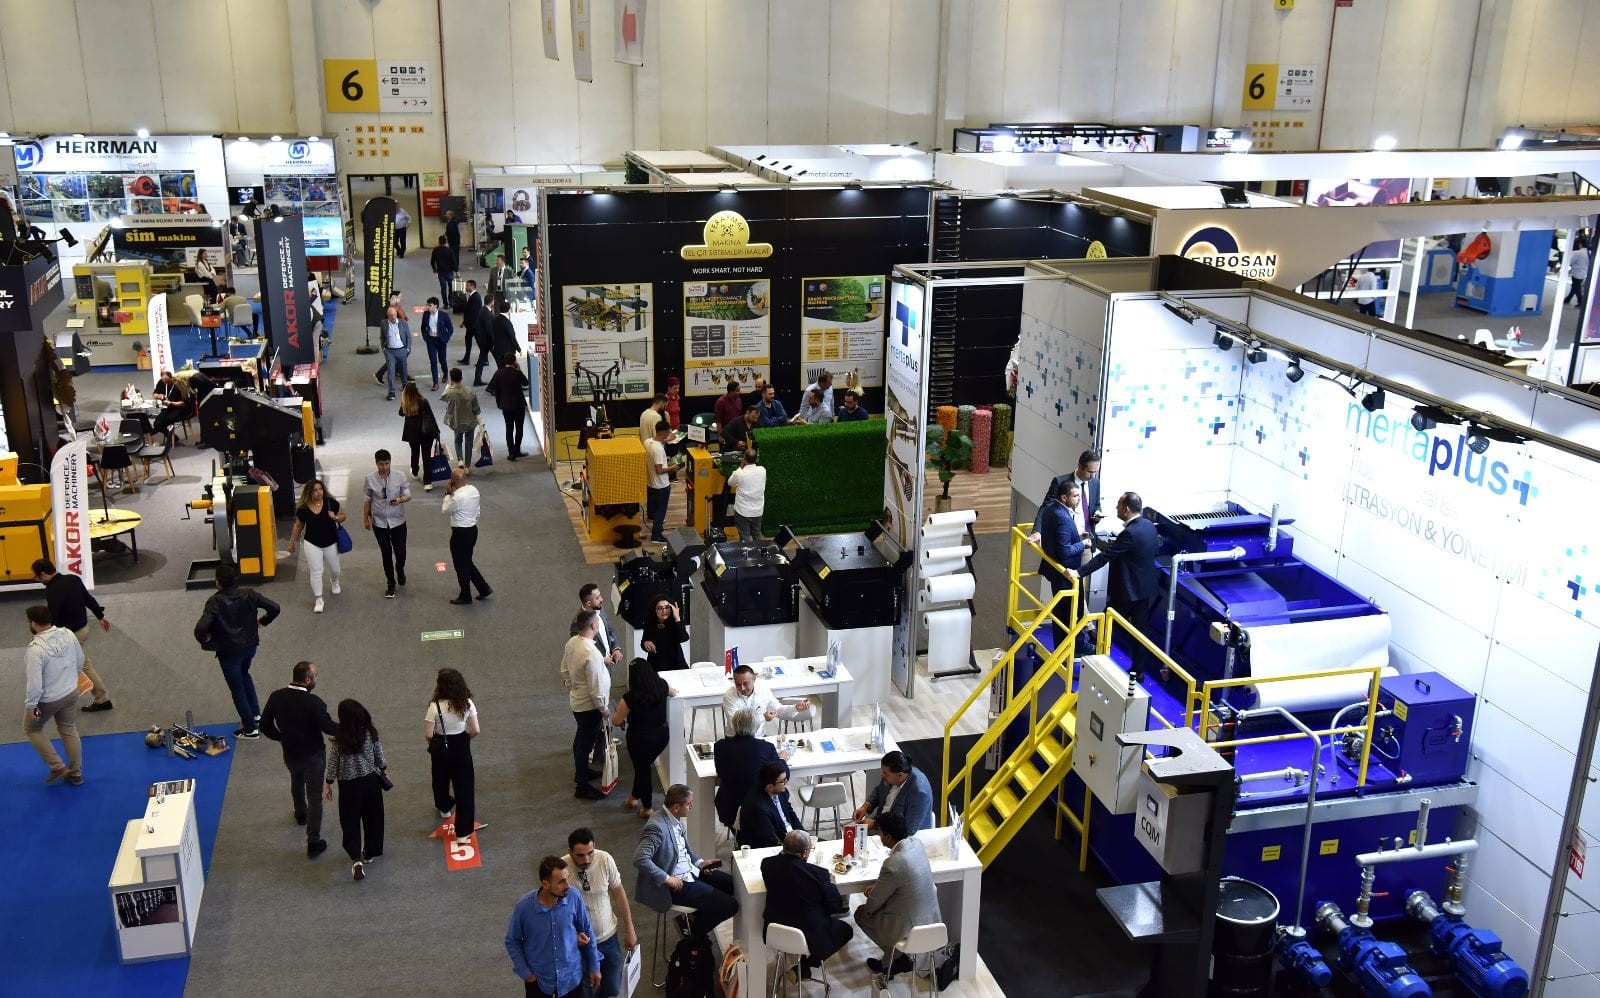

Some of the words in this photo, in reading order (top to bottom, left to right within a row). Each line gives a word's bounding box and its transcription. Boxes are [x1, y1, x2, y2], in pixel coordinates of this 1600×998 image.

[342, 70, 363, 101] 6
[1249, 72, 1264, 100] 6
[56, 140, 157, 154] HERRMAN
[126, 229, 155, 241] sim
[285, 236, 294, 288] MACHINERY
[1242, 268, 1275, 277] BORU
[367, 266, 379, 294] sim
[283, 290, 300, 348] AKOR
[1346, 402, 1509, 495] mertaplus
[70, 453, 79, 509] MACHINERY
[66, 511, 82, 576] AKOR
[1424, 520, 1435, 542] &
[1142, 816, 1159, 846] CQM
[451, 838, 474, 860] 5
